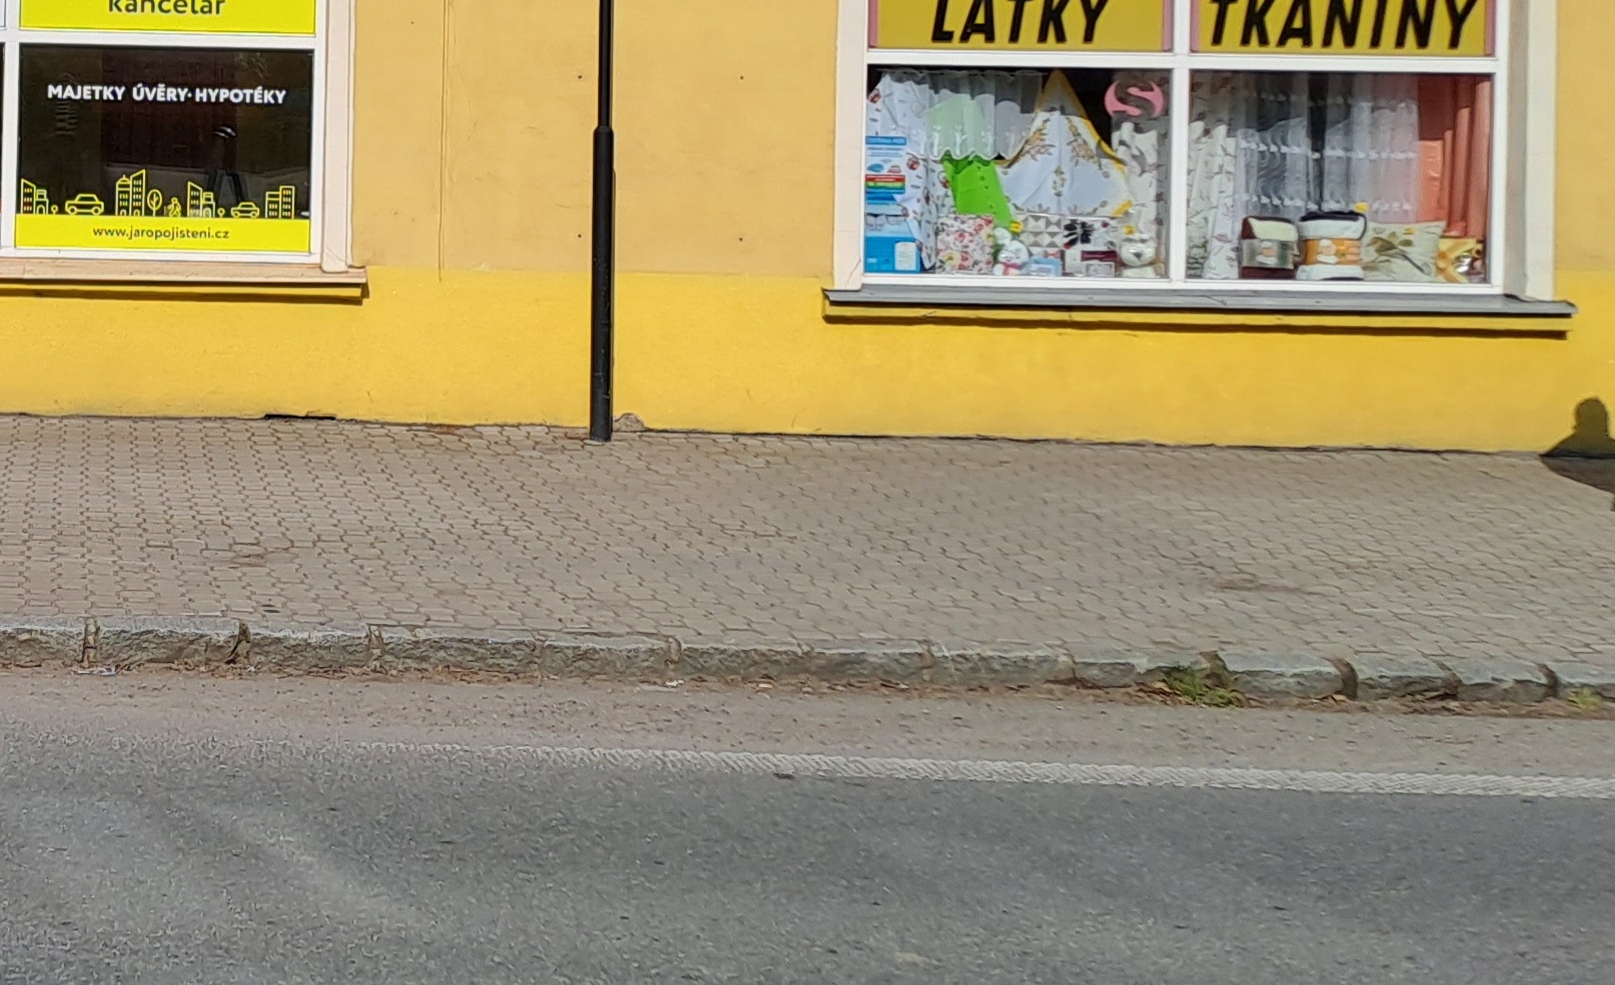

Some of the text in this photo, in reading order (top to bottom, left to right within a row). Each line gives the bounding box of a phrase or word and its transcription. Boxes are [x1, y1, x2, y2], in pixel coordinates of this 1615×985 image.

[47, 83, 287, 105] MAJETKY ÚVĚRY HYPOTÉKY
[92, 226, 230, 241] www.jaropojisteni.cz
